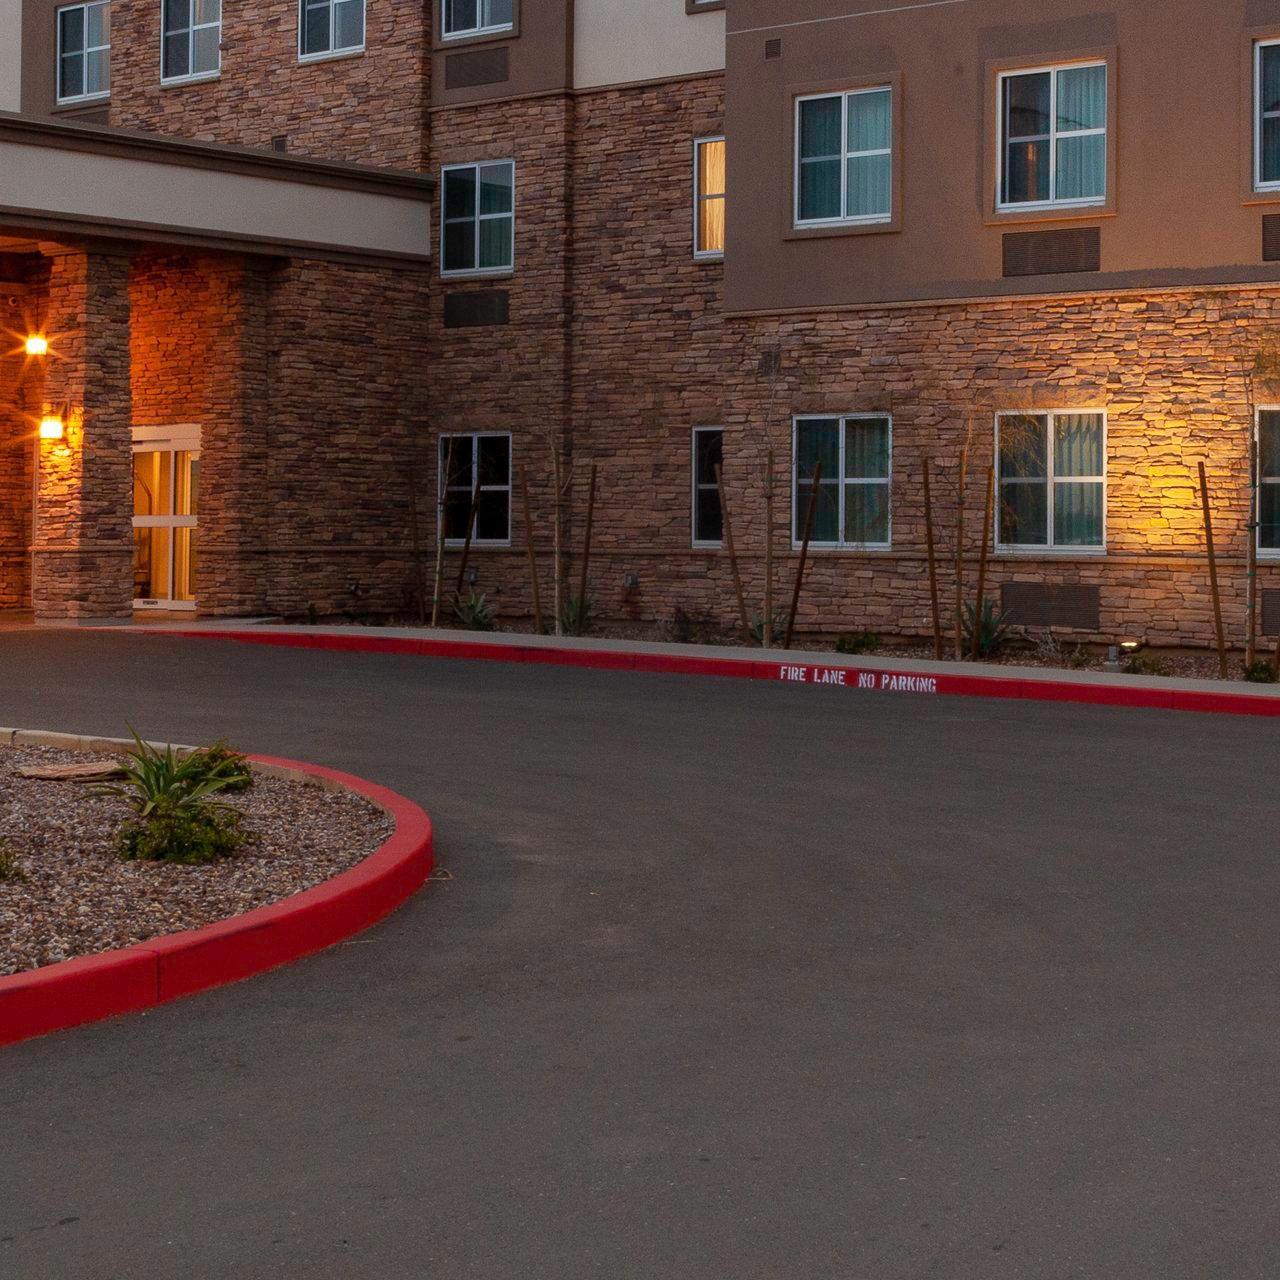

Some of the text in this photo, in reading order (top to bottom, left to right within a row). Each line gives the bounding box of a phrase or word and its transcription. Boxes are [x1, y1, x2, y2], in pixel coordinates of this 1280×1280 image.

[780, 666, 937, 693] FIRE LANE NO PARKING
